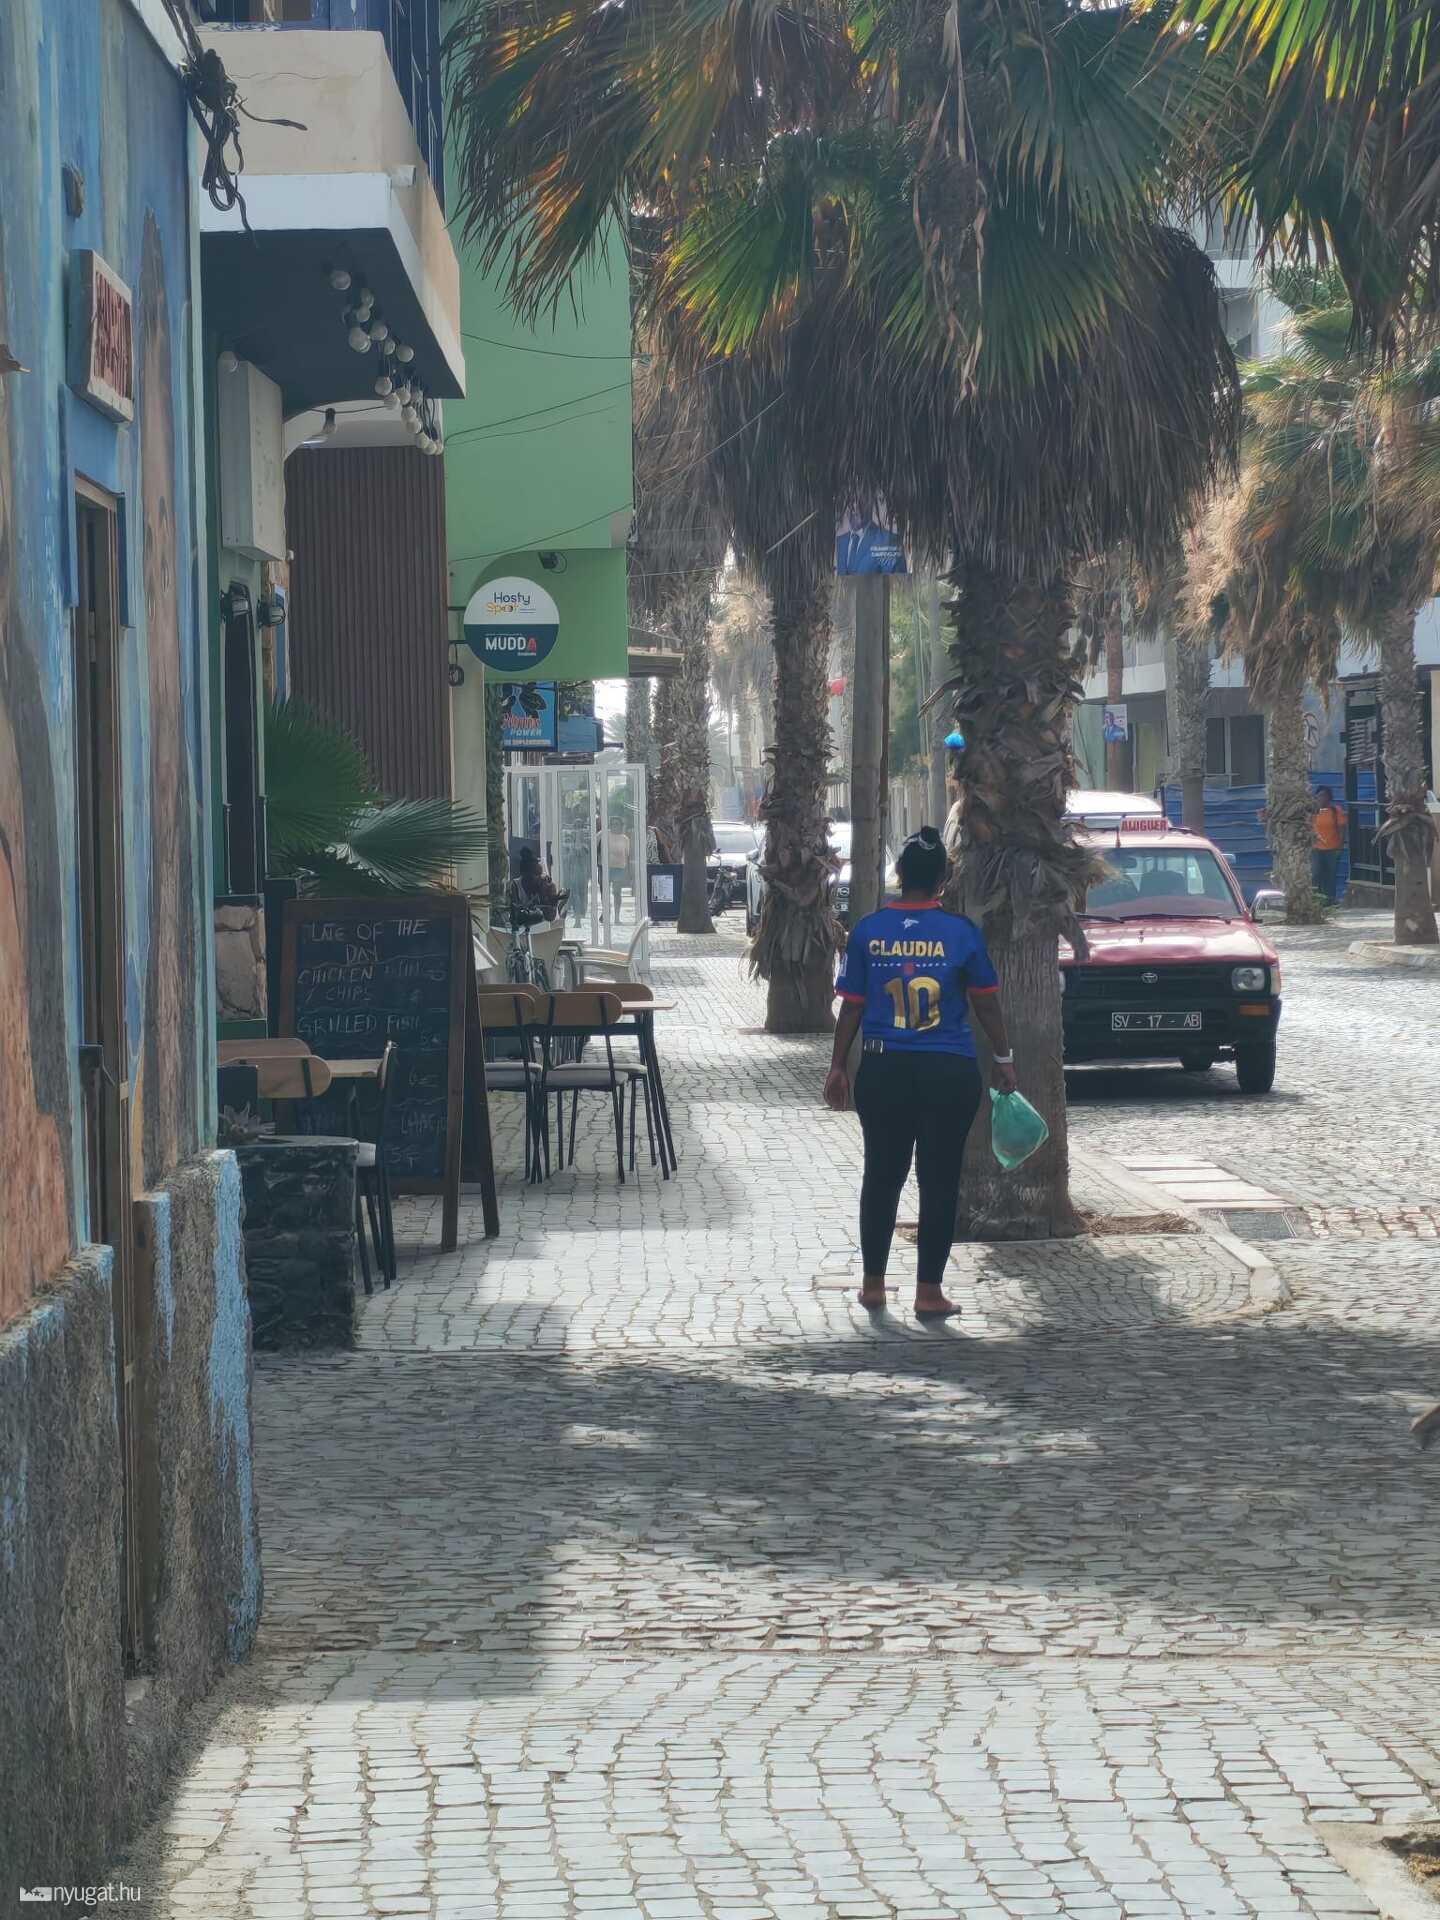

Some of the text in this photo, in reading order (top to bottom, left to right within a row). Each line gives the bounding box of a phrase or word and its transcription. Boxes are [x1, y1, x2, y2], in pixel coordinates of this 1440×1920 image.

[494, 592, 531, 606] Hosty
[357, 920, 384, 944] OF
[387, 919, 432, 936] THE
[346, 943, 378, 966] DAY
[869, 940, 945, 957] CLAUDIA
[297, 966, 374, 985] CHICKEN
[885, 976, 941, 1031] 10
[297, 1014, 420, 1036] GRILLED FISH
